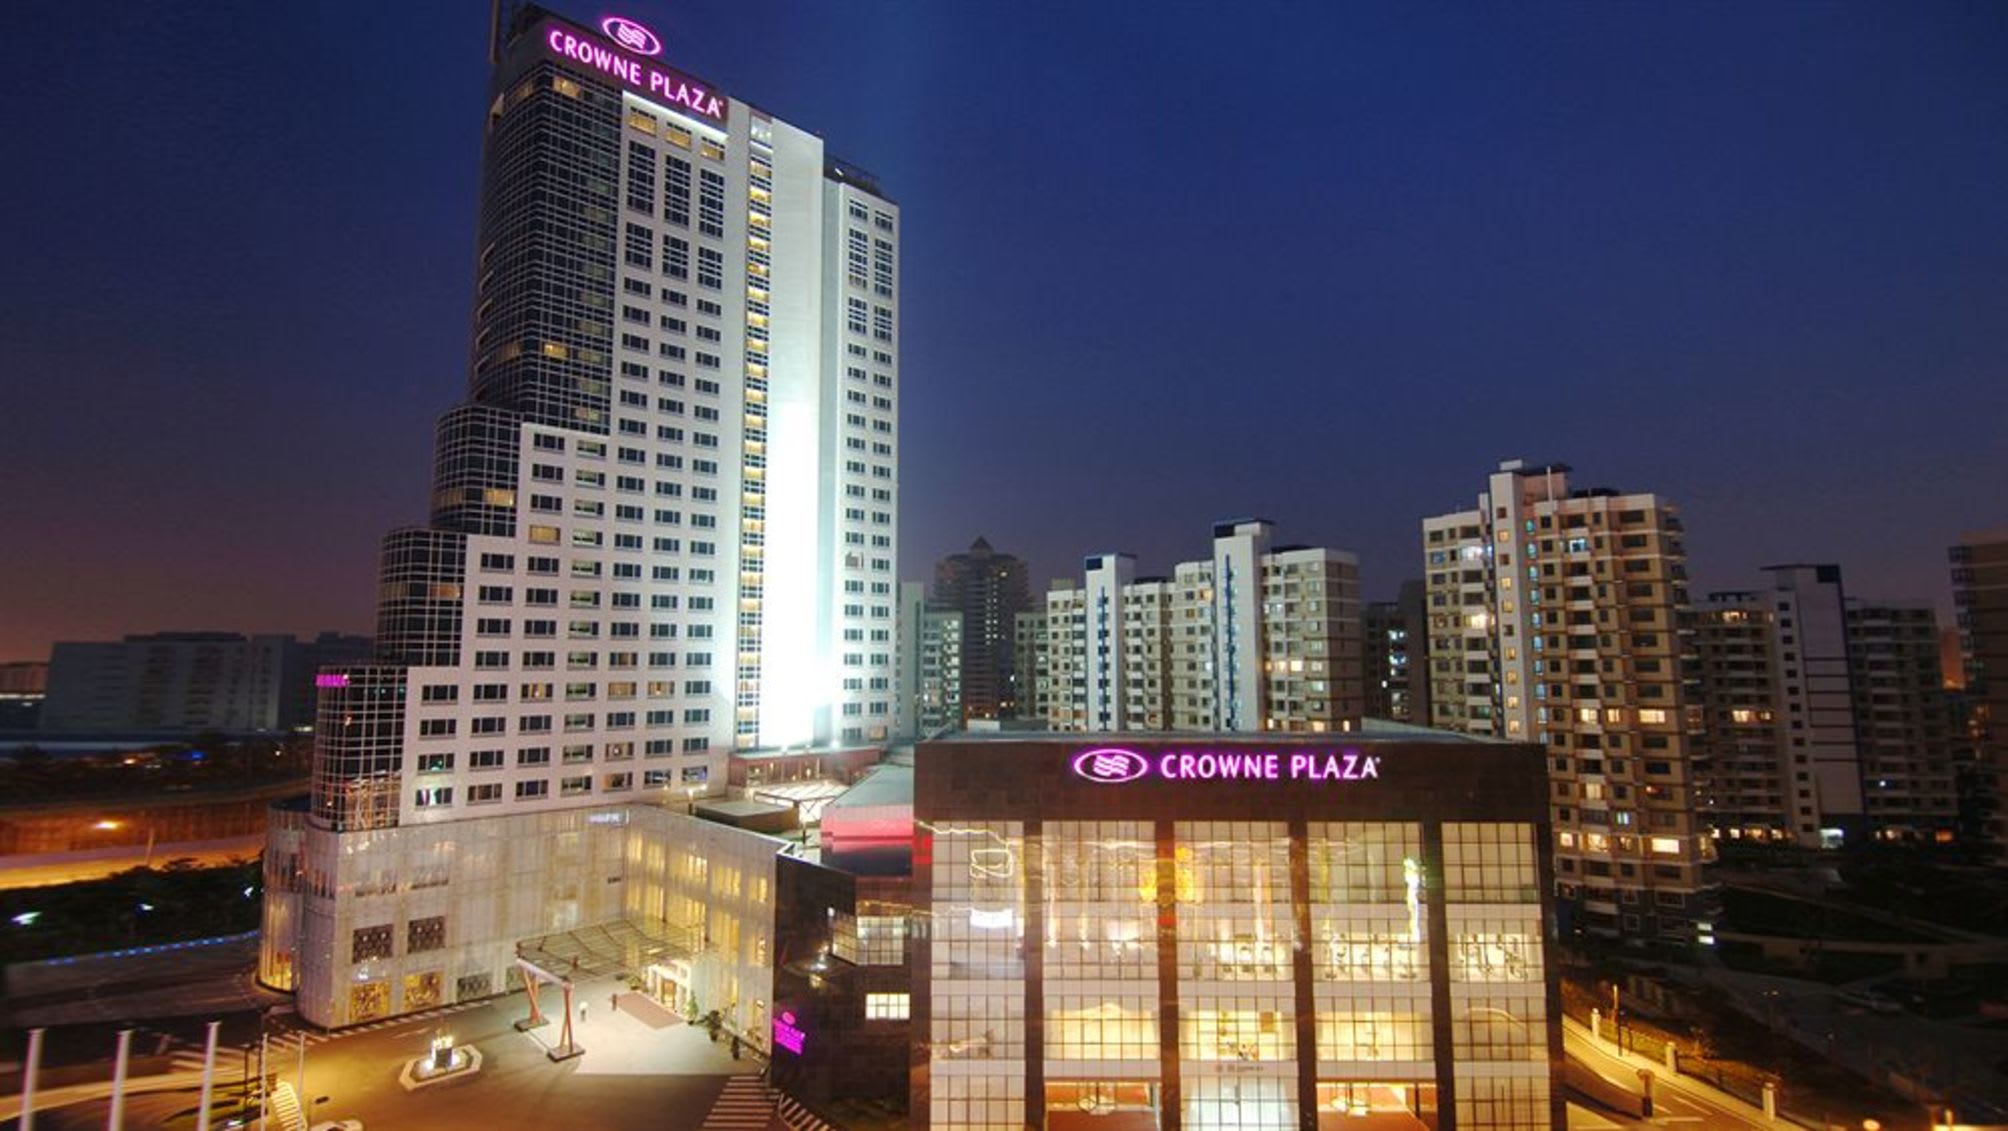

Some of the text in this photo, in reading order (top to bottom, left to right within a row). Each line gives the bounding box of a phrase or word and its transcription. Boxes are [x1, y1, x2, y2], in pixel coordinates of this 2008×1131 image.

[549, 30, 722, 119] CROWNE PLAZA
[1160, 754, 1378, 779] CROWNE PLAZA
